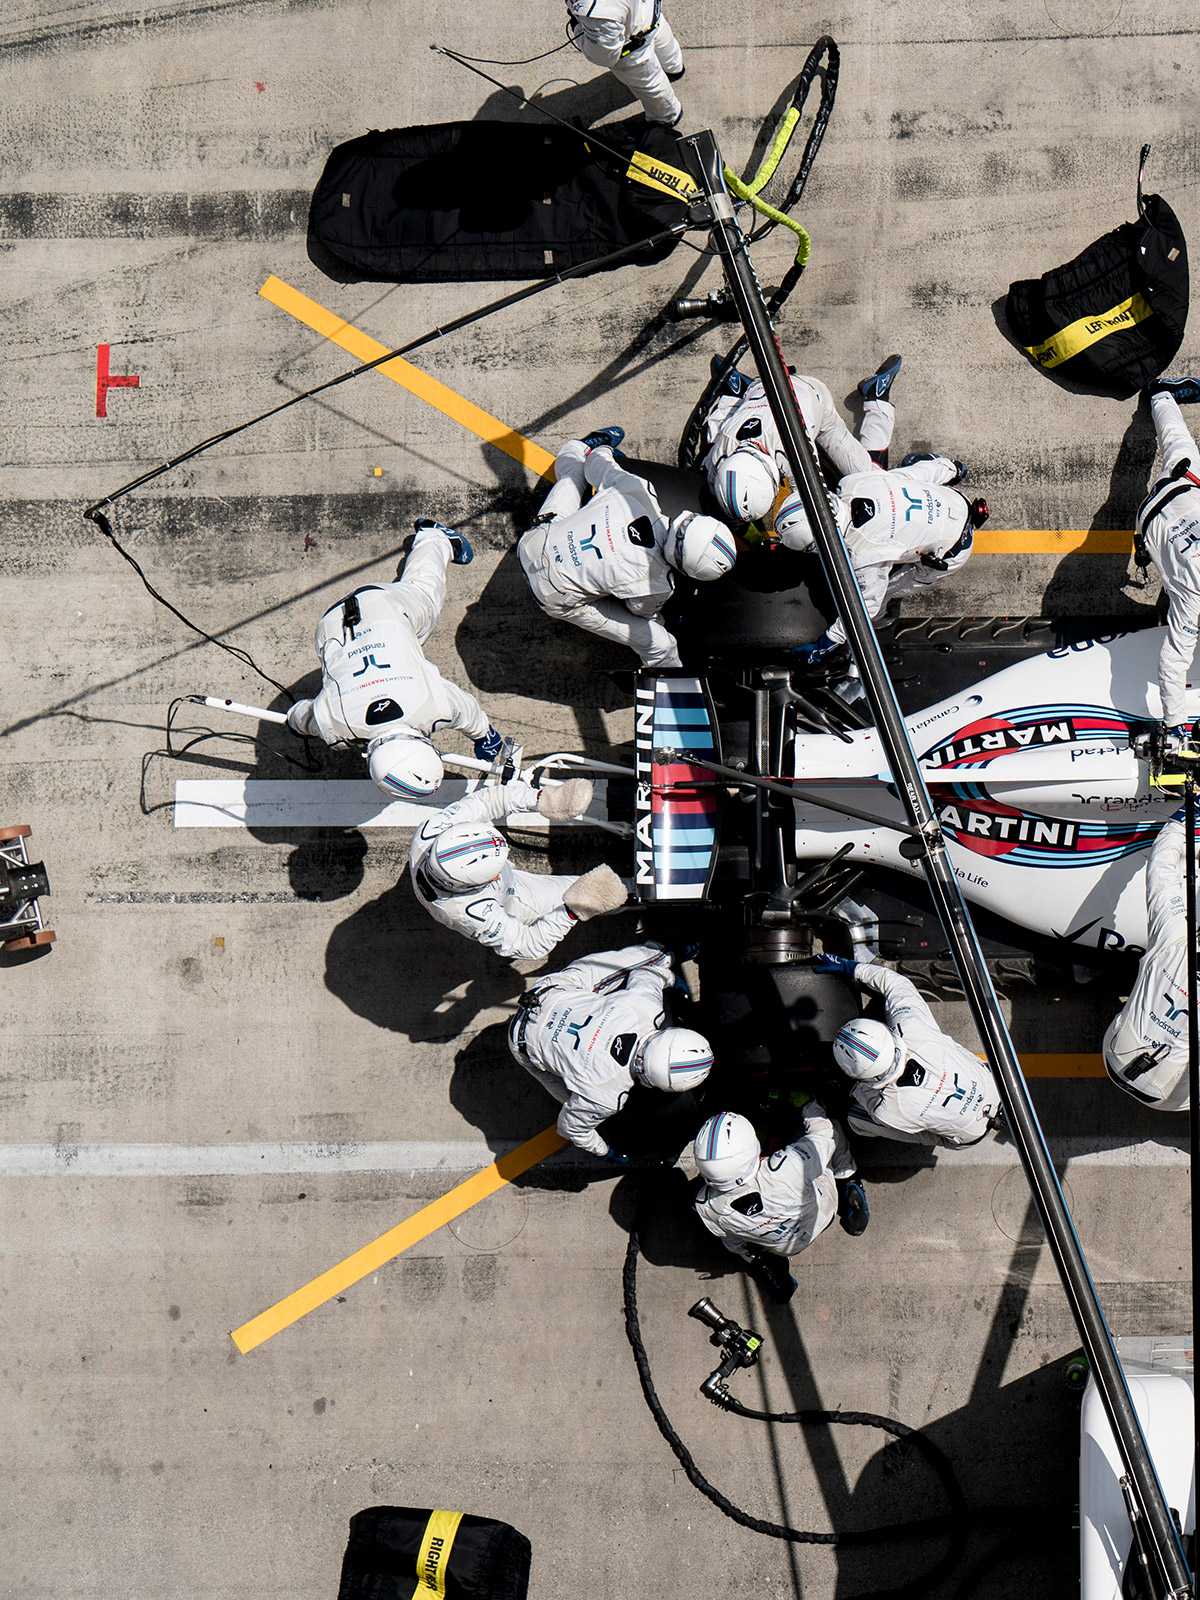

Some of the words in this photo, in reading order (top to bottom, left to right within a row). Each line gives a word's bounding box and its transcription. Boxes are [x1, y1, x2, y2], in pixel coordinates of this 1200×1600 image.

[647, 166, 680, 188] REAR
[924, 489, 932, 524] randstad
[605, 528, 615, 552] MARTINI
[1168, 518, 1200, 544] randstad
[565, 530, 582, 567] randstad
[346, 641, 385, 658] randstad
[358, 677, 384, 688] MARTINI
[917, 706, 960, 730] Canada
[918, 722, 1071, 769] MARTIN
[636, 688, 655, 885] MARTINI
[940, 805, 1075, 846] ARTINI
[967, 872, 989, 888] Life
[550, 1006, 573, 1043] randstad
[597, 1006, 615, 1029] WILLIAMS
[1147, 1010, 1181, 1038] randstad
[586, 1028, 600, 1053] MARTINI
[919, 1093, 937, 1117] WILLIAMS
[933, 1071, 948, 1094] MARTINI
[958, 1080, 978, 1116] randstad
[424, 1537, 444, 1574] RIGHT
